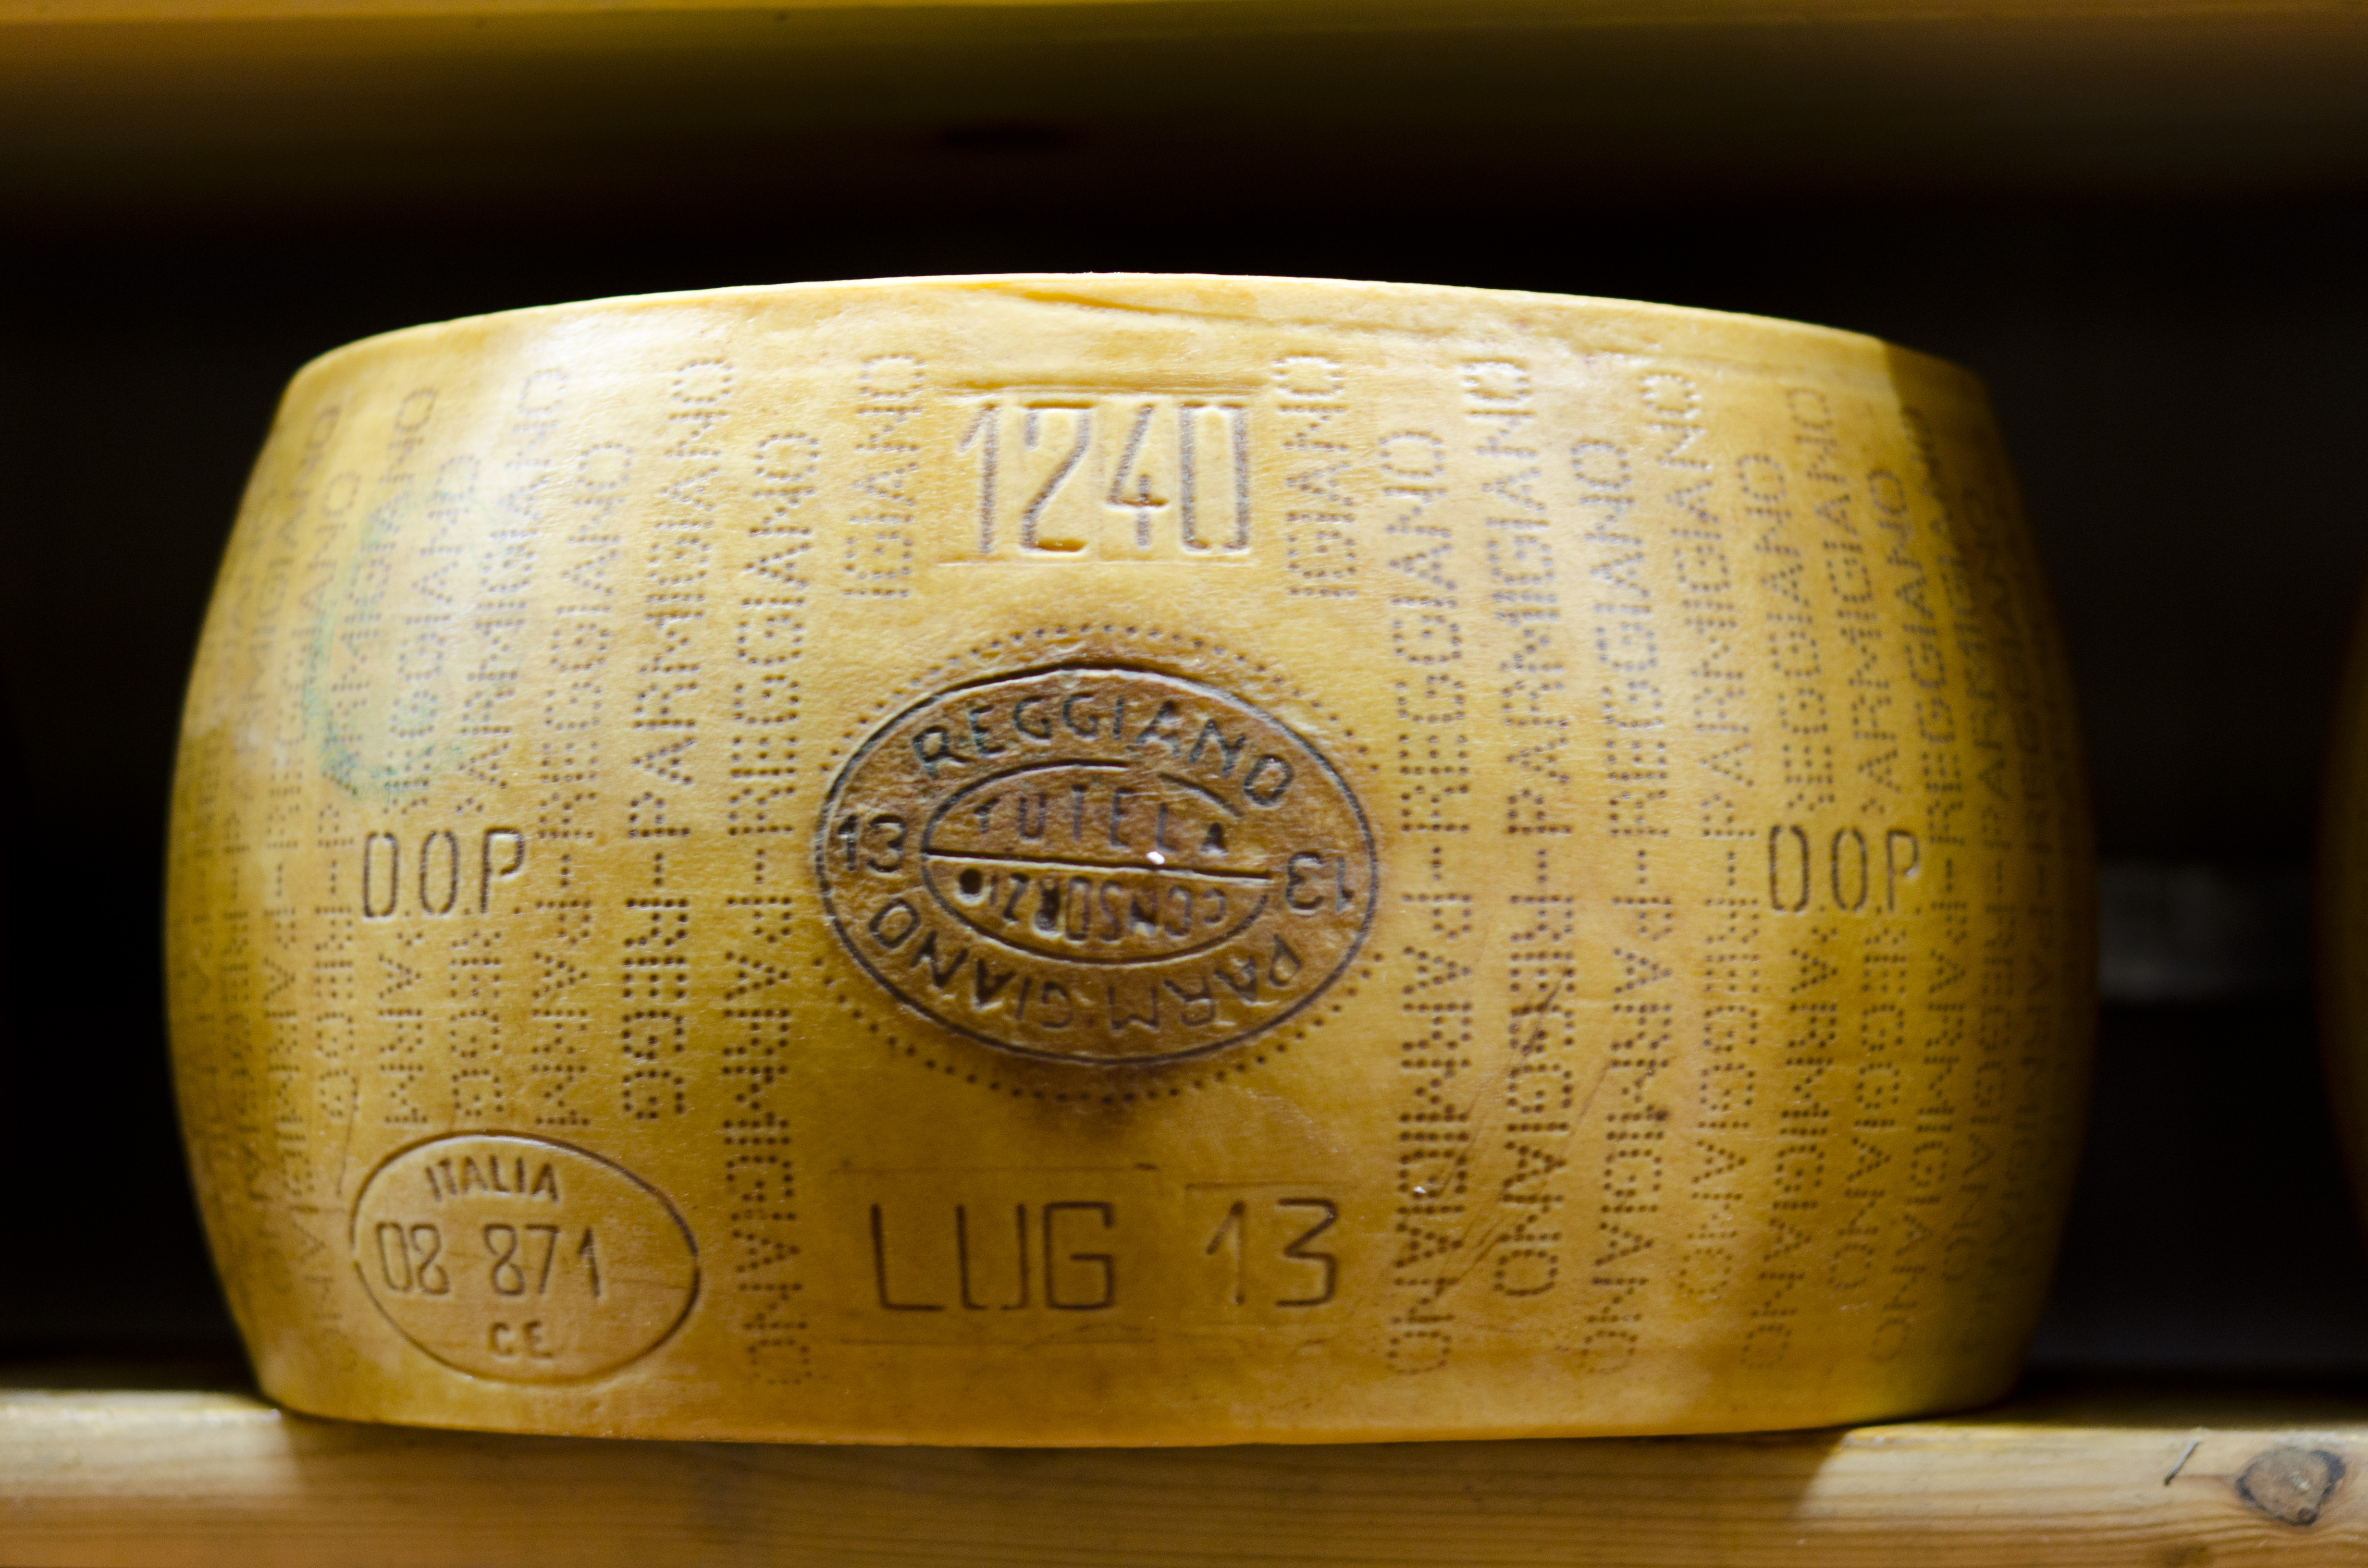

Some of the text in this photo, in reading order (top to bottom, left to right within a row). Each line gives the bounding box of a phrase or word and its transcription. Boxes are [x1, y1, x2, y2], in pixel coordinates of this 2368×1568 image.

[536, 442, 634, 837] REGGIANO
[629, 357, 734, 837] PARMIGIANO
[728, 432, 820, 836] REGGIANO
[957, 401, 1248, 555] 1240
[1378, 430, 1470, 833] REGGIANO
[1458, 357, 1571, 836] PARMIGIANO
[1569, 437, 1670, 837] REGGIANO
[1639, 370, 1756, 838] PARMIGIANO
[836, 812, 907, 873] 13
[909, 691, 1296, 808] REGGIANO
[972, 784, 1228, 858] TUTELA
[621, 897, 690, 1120] REGG
[721, 895, 813, 1386] PARMIGIANO
[867, 897, 1303, 1034] PARMGIANO
[1385, 892, 1474, 1375] PARMIGIANO
[1493, 894, 1577, 1298] REGGIANO
[1580, 895, 1673, 1375] PARMIGIANO
[1677, 897, 1760, 1295] REGGIANO
[376, 1222, 602, 1299] 08 871
[425, 1154, 560, 1202] ITALIA
[489, 1321, 554, 1359] CE
[869, 1196, 1338, 1311] LUG 13
